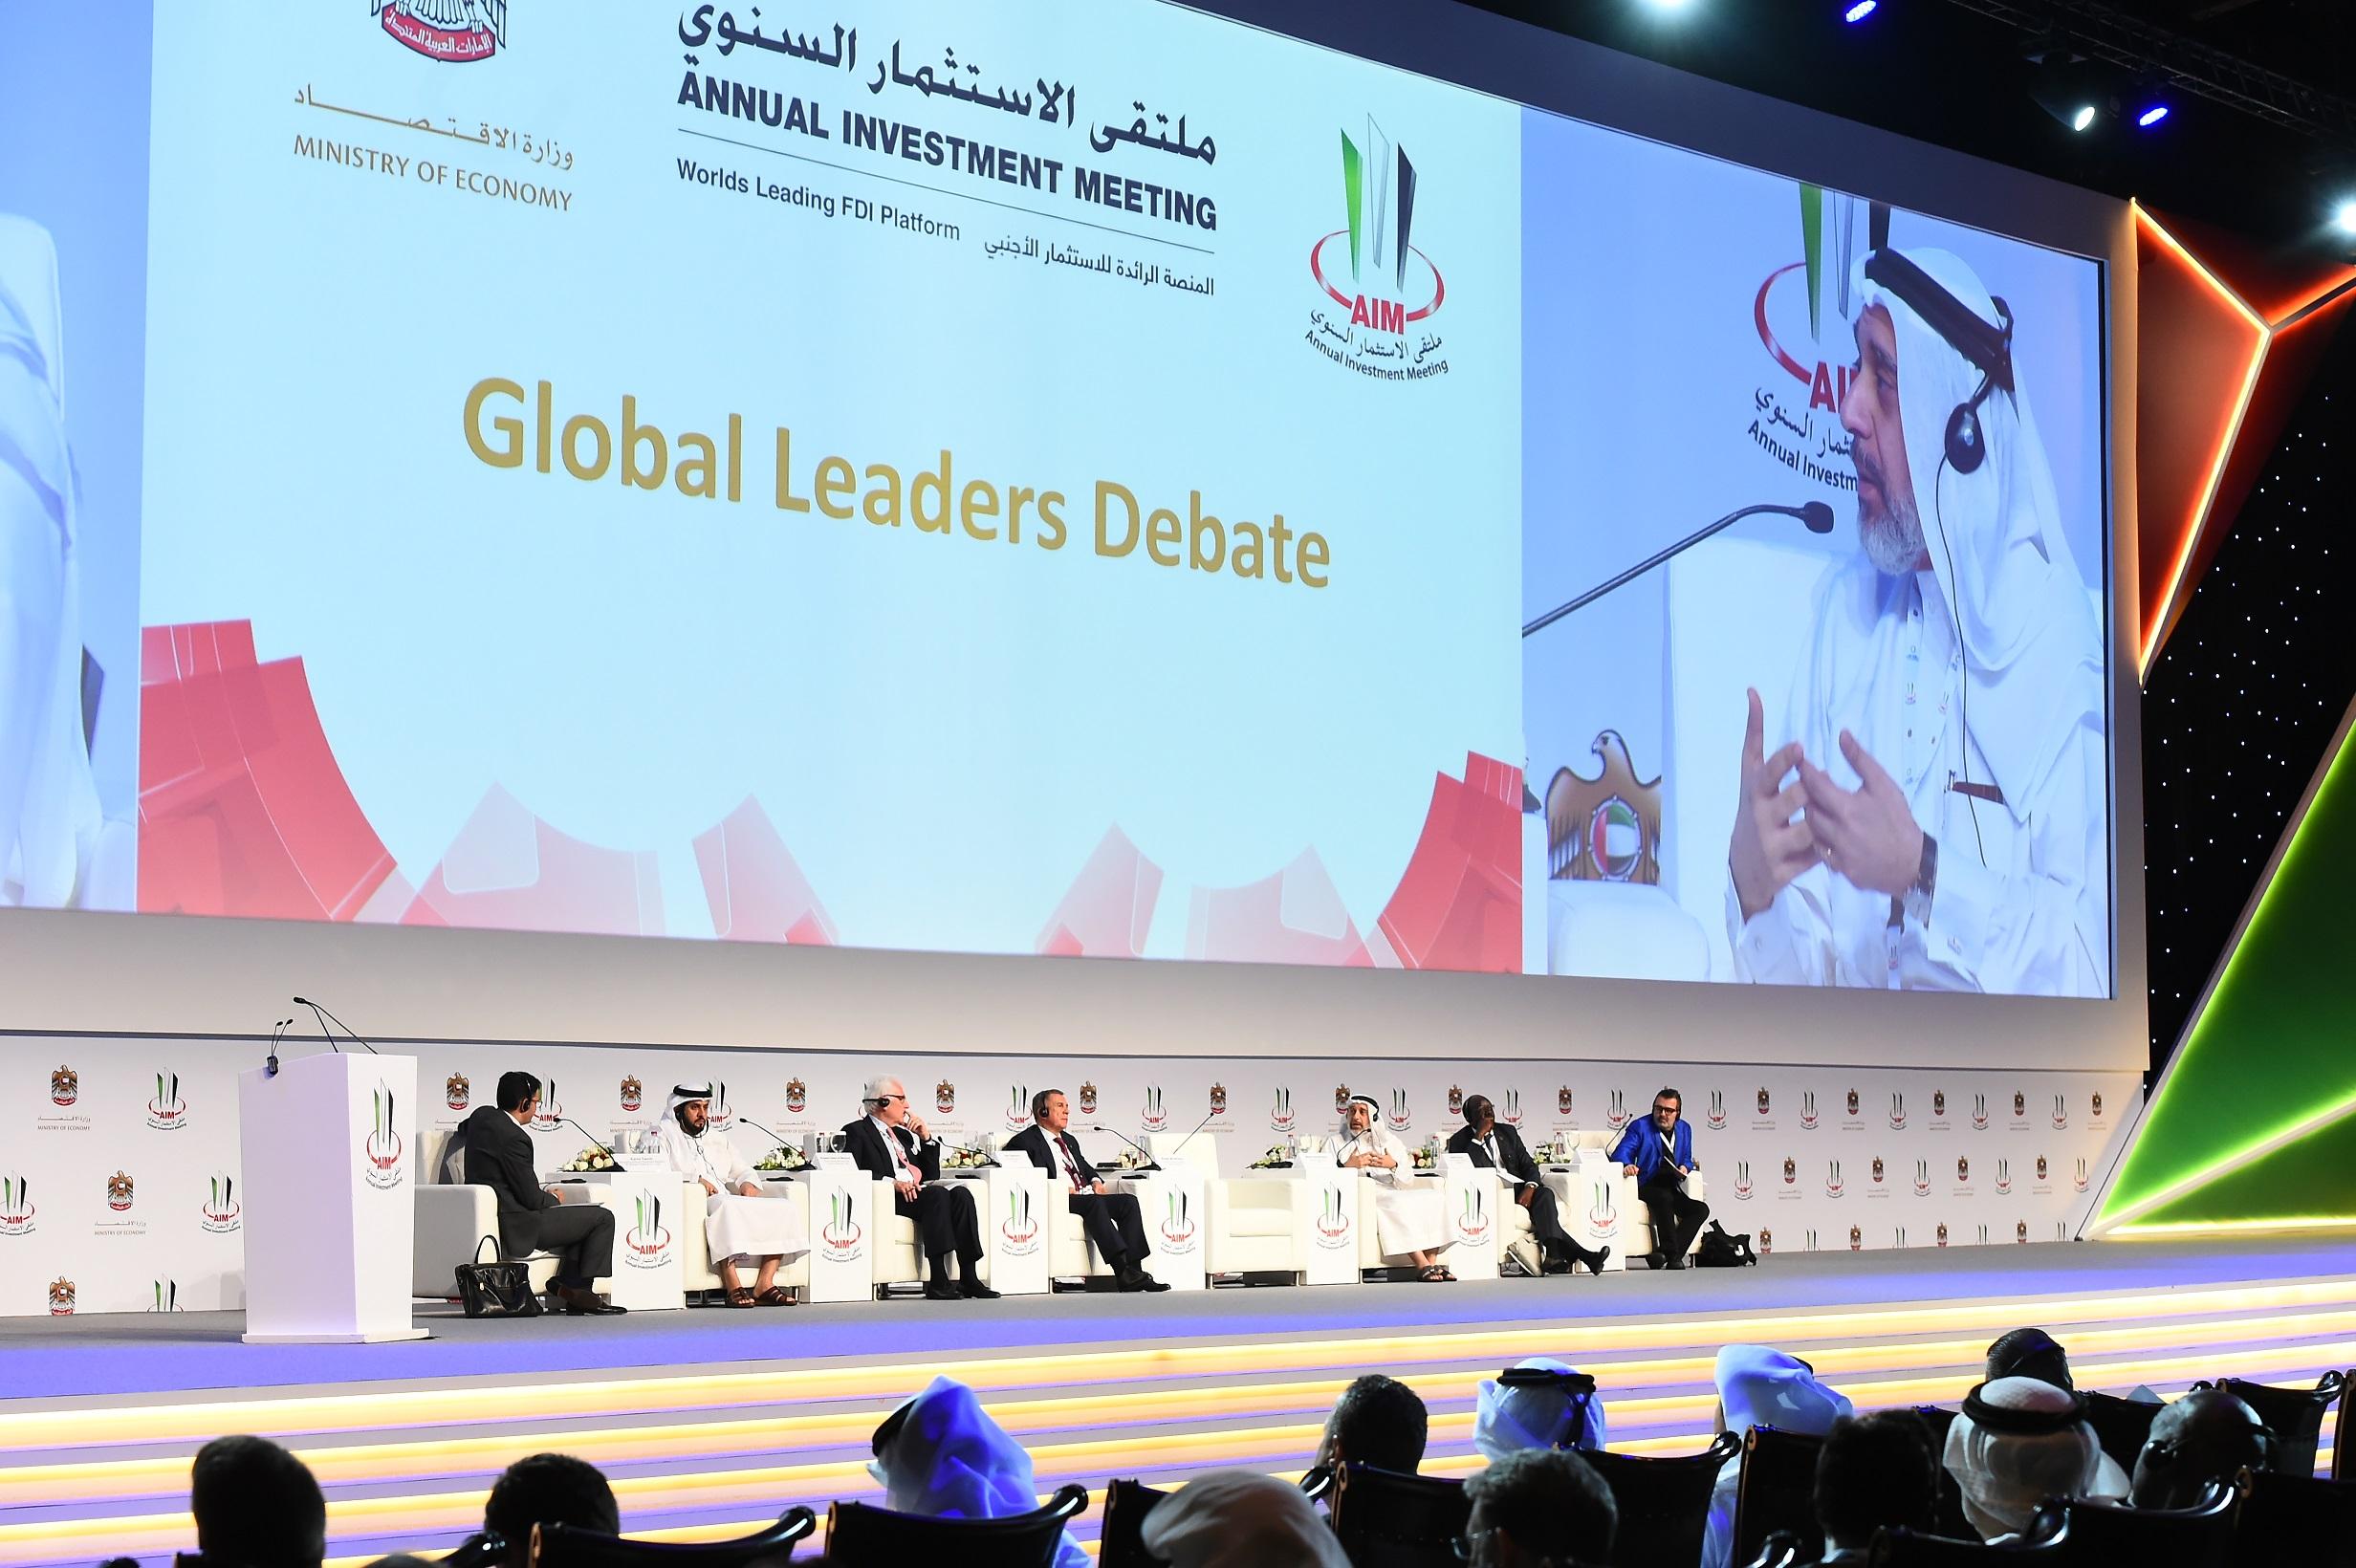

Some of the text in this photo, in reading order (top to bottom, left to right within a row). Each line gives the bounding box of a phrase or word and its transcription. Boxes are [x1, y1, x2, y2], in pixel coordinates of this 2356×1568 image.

[678, 4, 1217, 166] ملتقى الاستثمار السنوي
[294, 83, 574, 170] وزارة الاقتصاد
[294, 134, 573, 211] MINISTRY OF ECONOMY
[677, 71, 1217, 231] ANNUAL INVESTMENT MEETING
[677, 158, 961, 243] Worlds Leading FDI Platform
[984, 234, 1215, 296] المنصة الرائدة للاستثمار الأجنبي
[1310, 308, 1443, 364] ملتقى الاستثمار السنوي
[1351, 294, 1405, 336] AIM
[1304, 329, 1449, 381] Annual Investment Meeting
[1809, 360, 1859, 414] AI
[1748, 418, 1800, 471] Annual
[1802, 454, 1858, 492] Investm
[463, 376, 1330, 589] Global Leaders Debate
[160, 1111, 175, 1120] AIM
[539, 1114, 554, 1122] AIM
[710, 1115, 723, 1123] AIM
[377, 1156, 392, 1169] AIM
[7, 1215, 23, 1225] AIM
[213, 1213, 229, 1222] AIM
[1014, 1233, 1027, 1244] AIM
[1171, 1233, 1185, 1243] AIM
[640, 1244, 657, 1254] AIM
[835, 1239, 850, 1249] AIM
